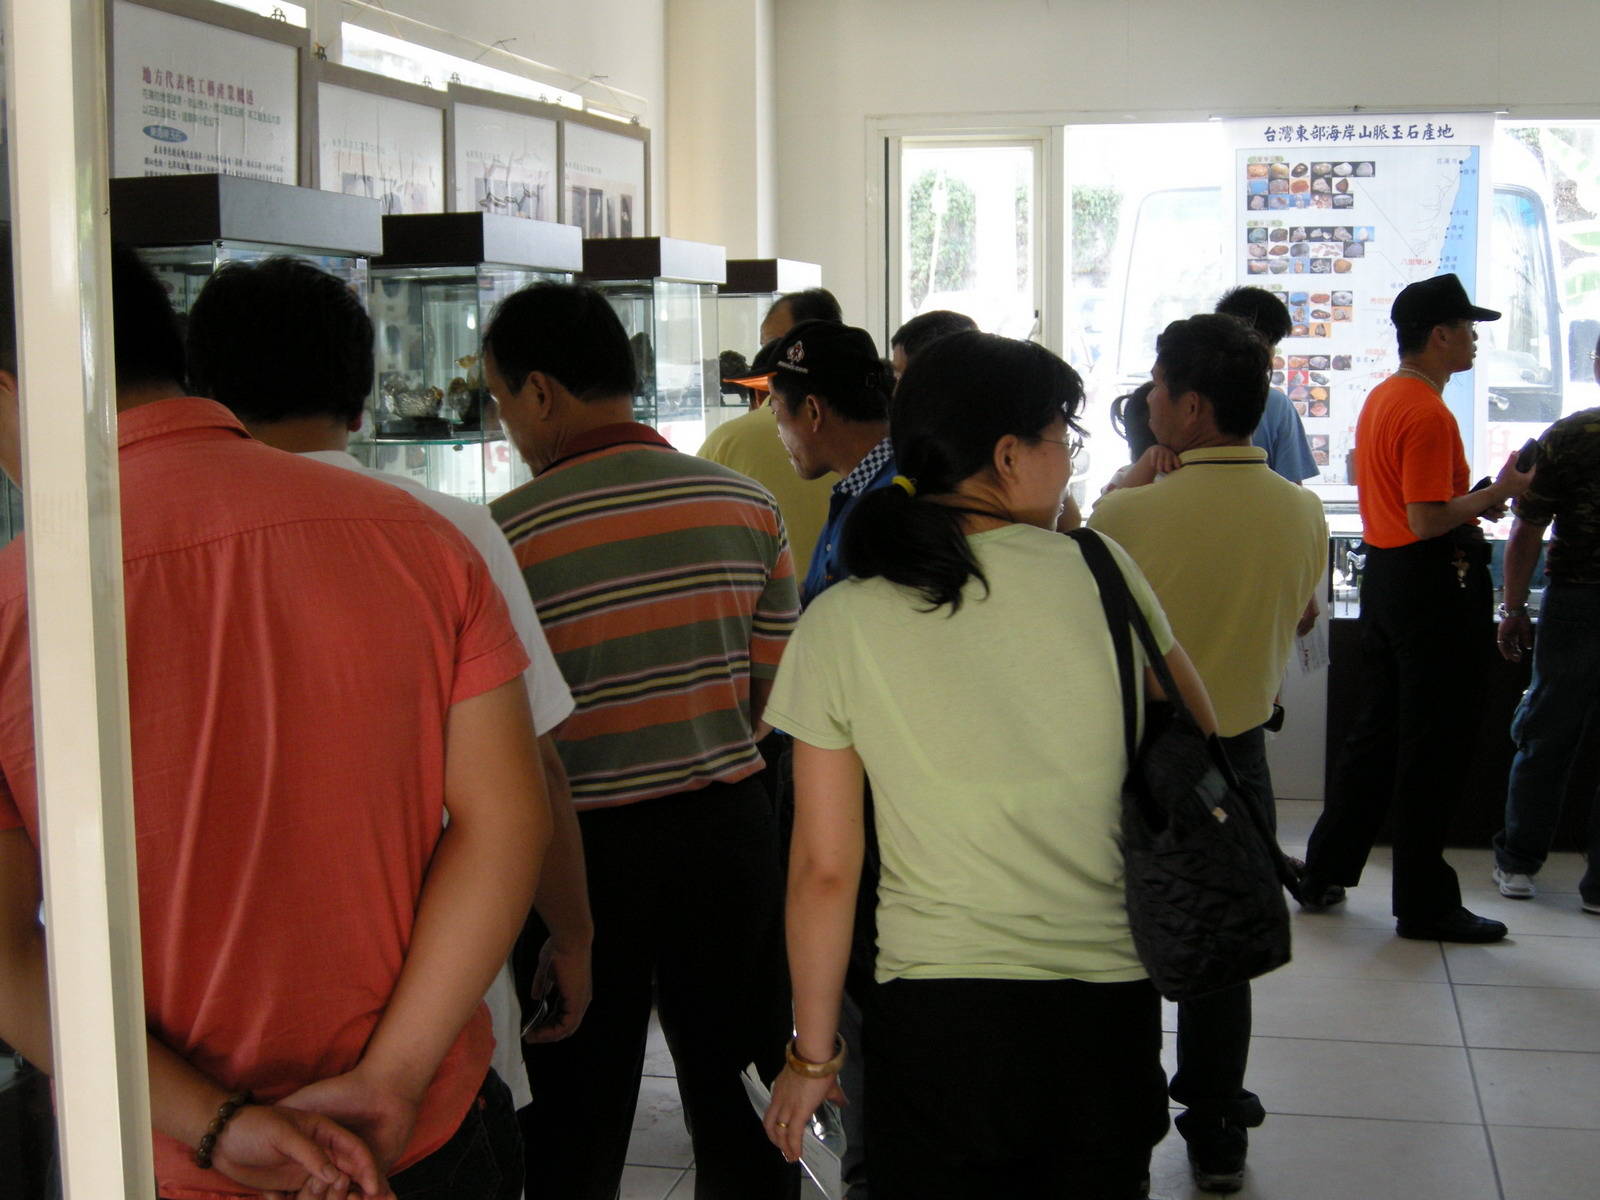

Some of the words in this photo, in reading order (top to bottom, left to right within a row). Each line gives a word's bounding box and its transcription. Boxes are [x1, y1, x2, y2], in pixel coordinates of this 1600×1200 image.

[1264, 123, 1455, 143] 台灣東部海岸山脈玉石產地
